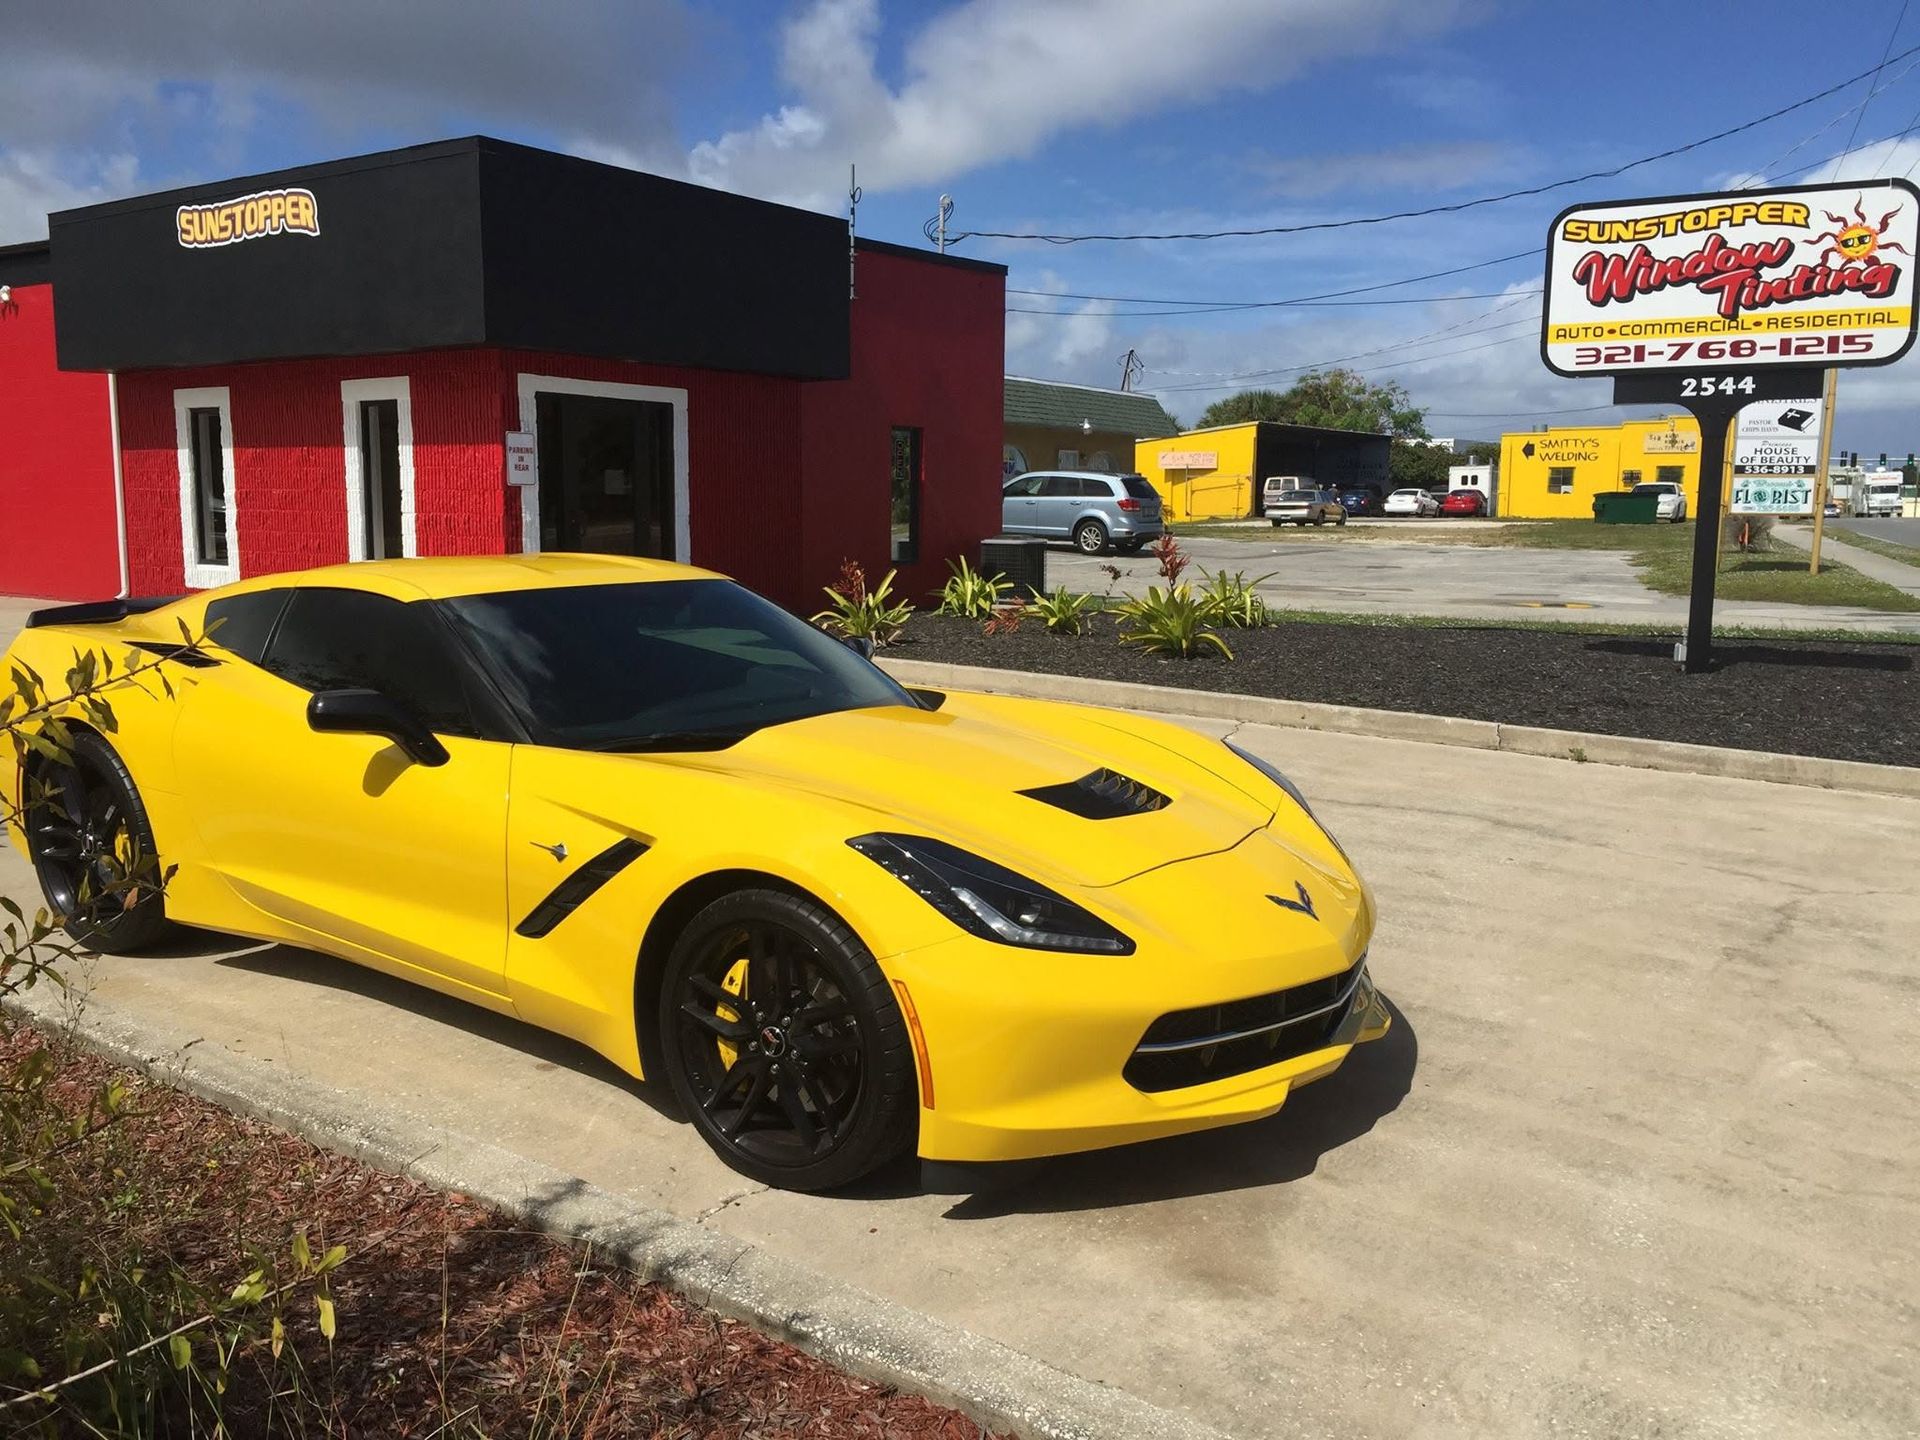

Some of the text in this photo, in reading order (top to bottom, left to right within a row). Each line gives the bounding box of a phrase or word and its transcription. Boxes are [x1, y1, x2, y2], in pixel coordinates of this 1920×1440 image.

[179, 191, 317, 244] SUNSTOPPER
[1563, 201, 1810, 243] SUNSTOPPER
[1573, 234, 1795, 307] Window
[1699, 262, 1901, 319] Tinting
[1556, 311, 1899, 340] AUTO COMMERCIAL RESIDENTIAL
[1575, 334, 1874, 366] 321-768-1215
[1680, 376, 1756, 397] 2544
[509, 446, 533, 454] PARKING
[1539, 438, 1600, 449] SMITTY'S
[1754, 447, 1799, 455] HOUSE
[1539, 451, 1599, 462] WELDING
[1740, 455, 1811, 464] OF BEAUTY
[1744, 465, 1805, 474] 536-8913
